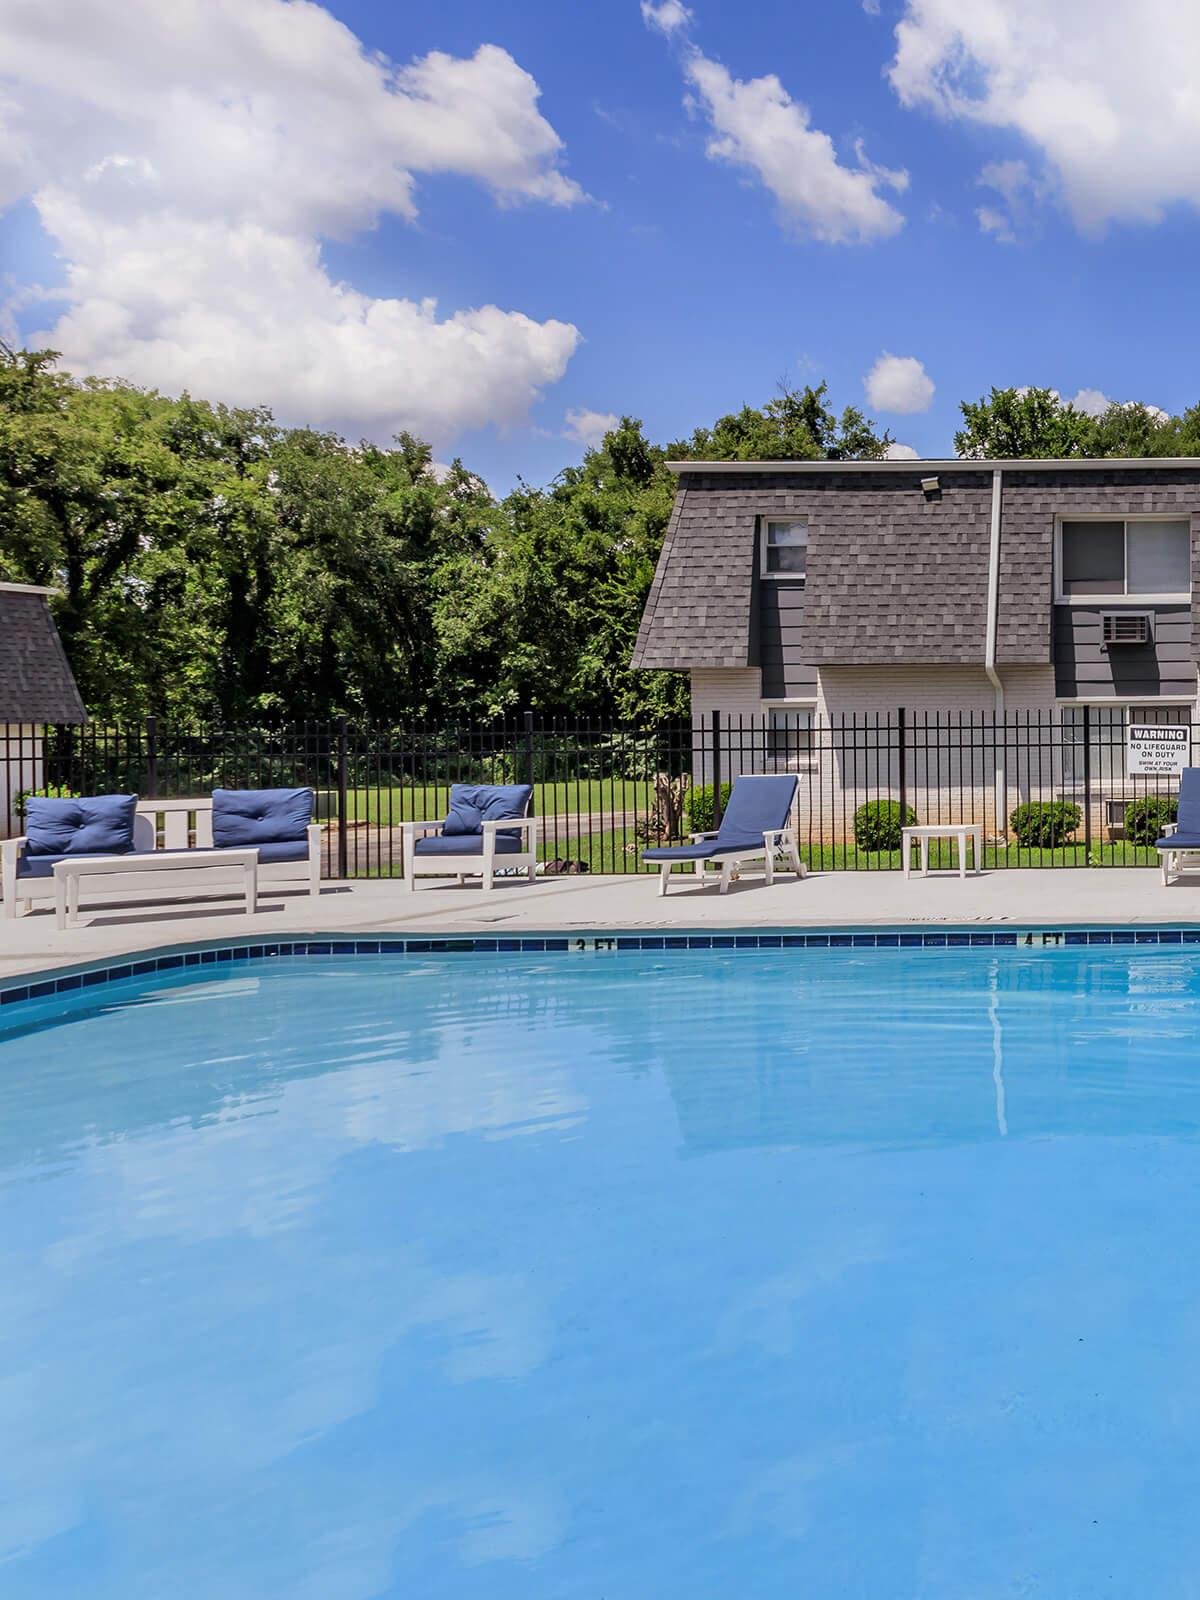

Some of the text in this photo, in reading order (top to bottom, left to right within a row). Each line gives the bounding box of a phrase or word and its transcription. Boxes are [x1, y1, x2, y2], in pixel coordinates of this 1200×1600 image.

[1134, 730, 1184, 740] WARNING
[1144, 743, 1187, 751] LIFEGUARD
[594, 938, 616, 950] FT
[1024, 932, 1063, 945] 4 FT
